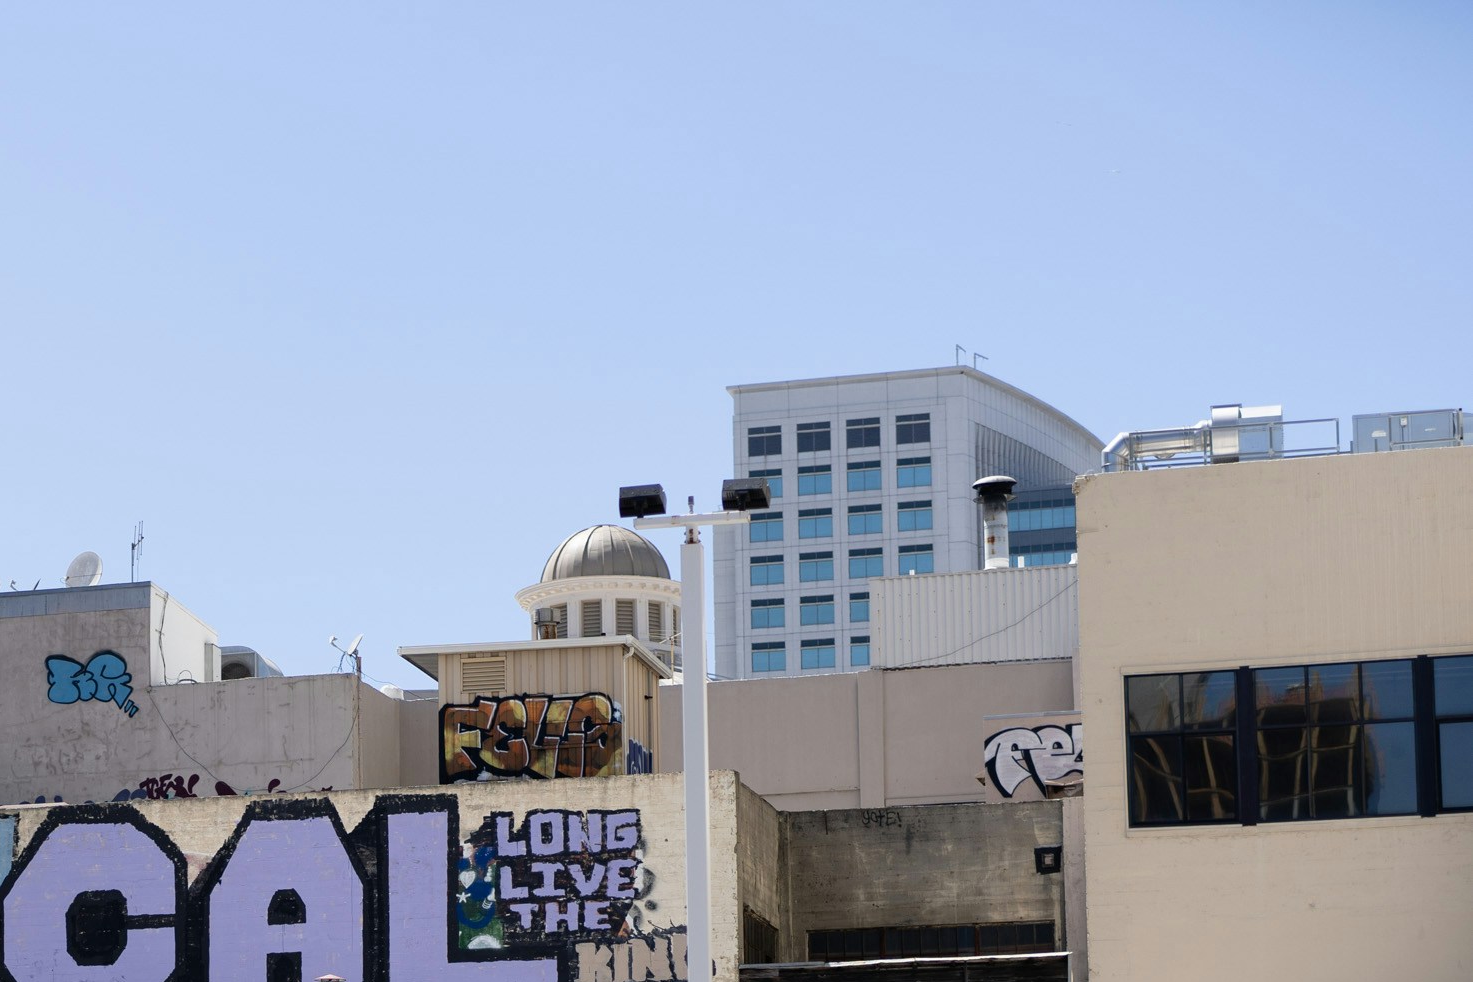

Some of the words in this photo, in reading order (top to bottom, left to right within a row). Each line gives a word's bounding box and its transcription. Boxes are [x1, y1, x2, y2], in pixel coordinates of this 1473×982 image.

[496, 811, 639, 857] LONG
[499, 859, 638, 900] LIVE
[510, 901, 612, 934] THE
